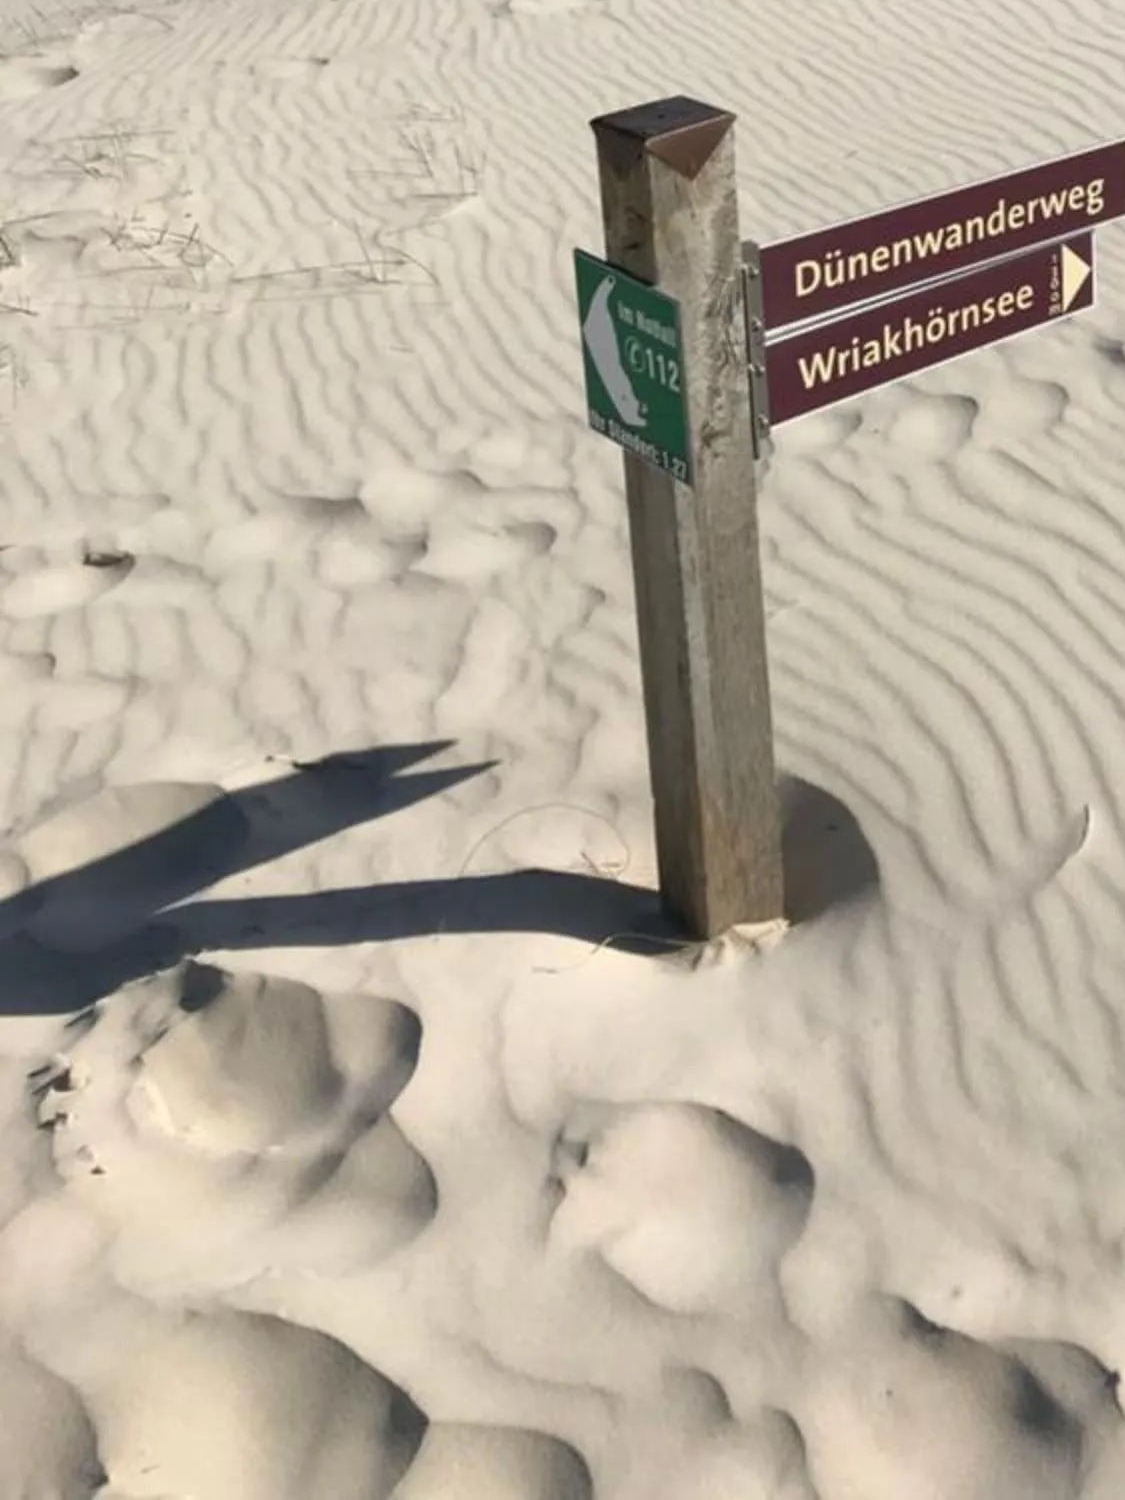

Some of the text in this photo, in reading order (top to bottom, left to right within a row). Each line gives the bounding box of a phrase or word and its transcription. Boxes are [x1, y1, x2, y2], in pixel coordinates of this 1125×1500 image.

[794, 178, 1105, 298] Dünenwanderweg
[647, 347, 681, 393] 112
[797, 284, 1034, 389] Wriakhörnsee
